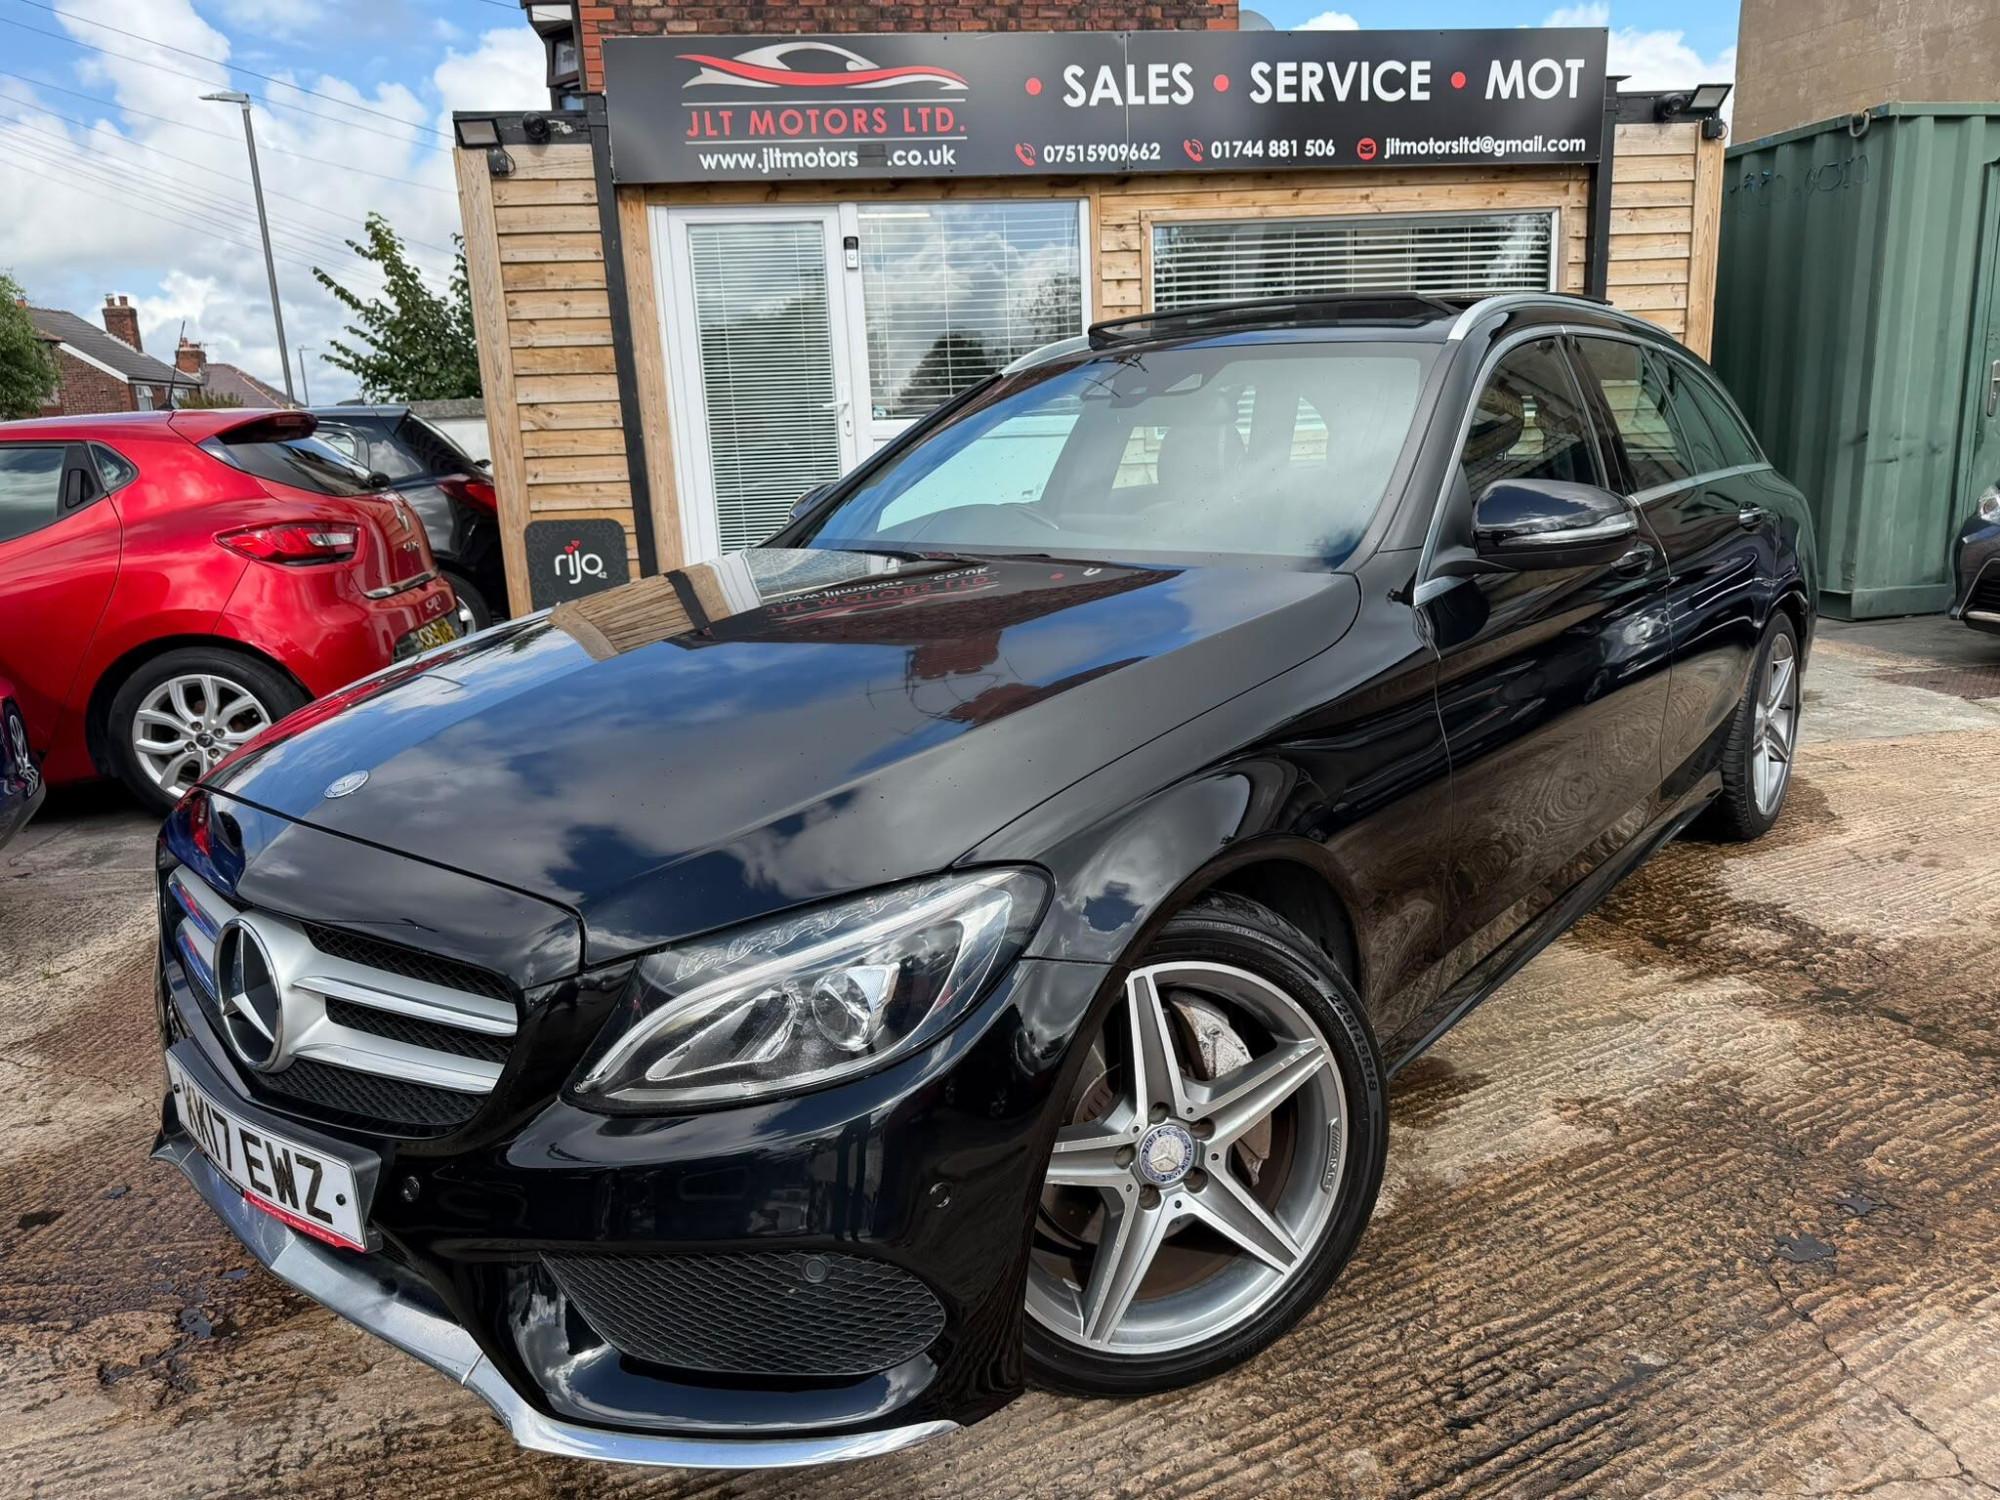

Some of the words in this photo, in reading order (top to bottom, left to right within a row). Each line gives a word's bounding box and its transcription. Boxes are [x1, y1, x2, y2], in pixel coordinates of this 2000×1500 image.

[1062, 62, 1195, 108] SALES
[1249, 60, 1432, 104] SERVICE
[1484, 58, 1586, 101] MOT
[685, 111, 733, 138] JLT
[749, 108, 888, 137] MOTORS
[903, 106, 967, 134] LTD.
[1043, 141, 1162, 164] 07515909662
[1210, 139, 1264, 160] 01744
[1268, 138, 1298, 159] 881
[1304, 138, 1336, 158] 506
[1384, 134, 1587, 160] jltmotorsltd@gmail.com
[238, 1126, 334, 1226] EWZ
